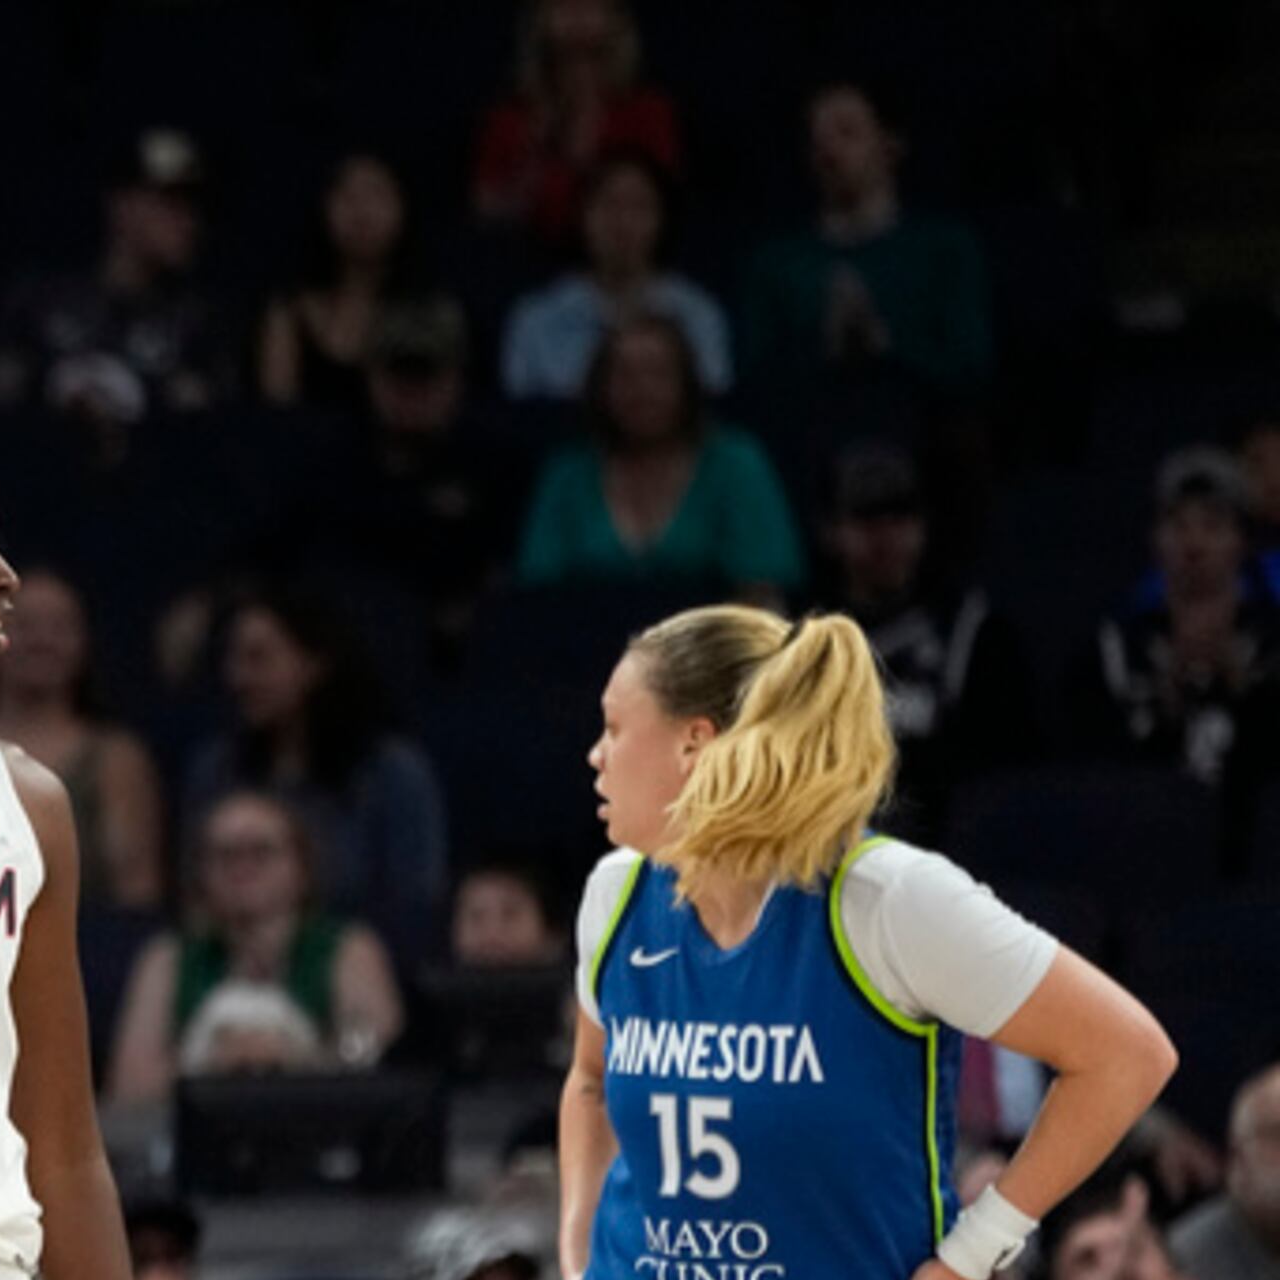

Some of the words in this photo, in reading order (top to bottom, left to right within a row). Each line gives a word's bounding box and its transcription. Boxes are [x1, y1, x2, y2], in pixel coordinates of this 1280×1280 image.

[608, 1015, 824, 1083] MINNESOTA
[650, 1094, 740, 1199] 15
[643, 1216, 769, 1259] MAYO
